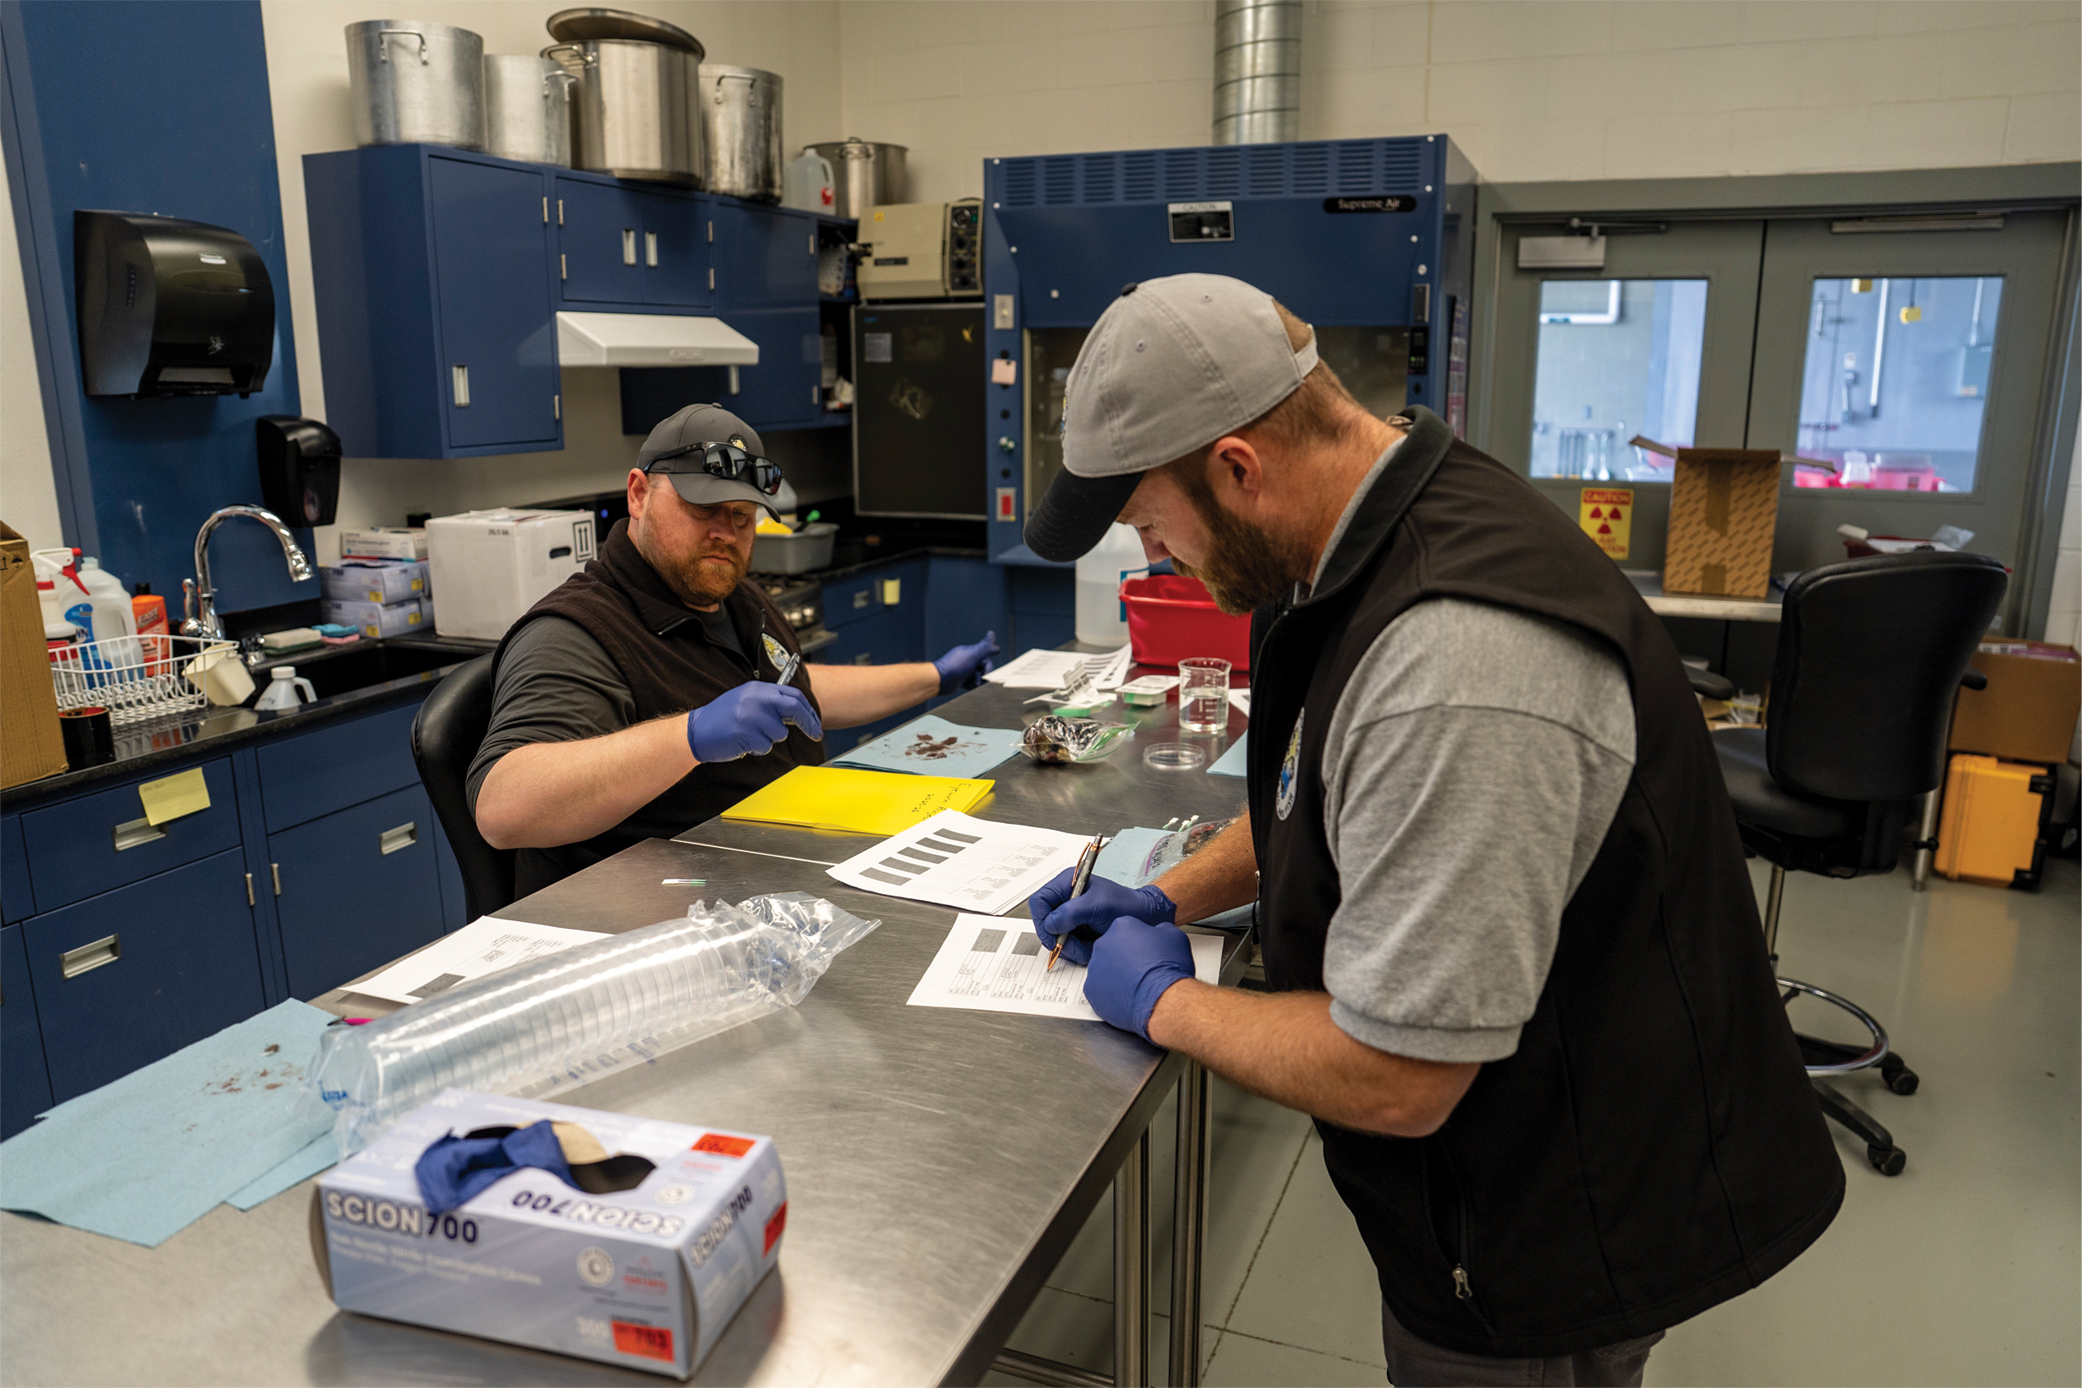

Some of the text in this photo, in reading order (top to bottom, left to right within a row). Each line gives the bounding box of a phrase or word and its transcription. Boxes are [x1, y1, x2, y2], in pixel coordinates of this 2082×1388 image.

[1337, 197, 1401, 211] Supreme Air
[1585, 491, 1631, 503] CAUTION
